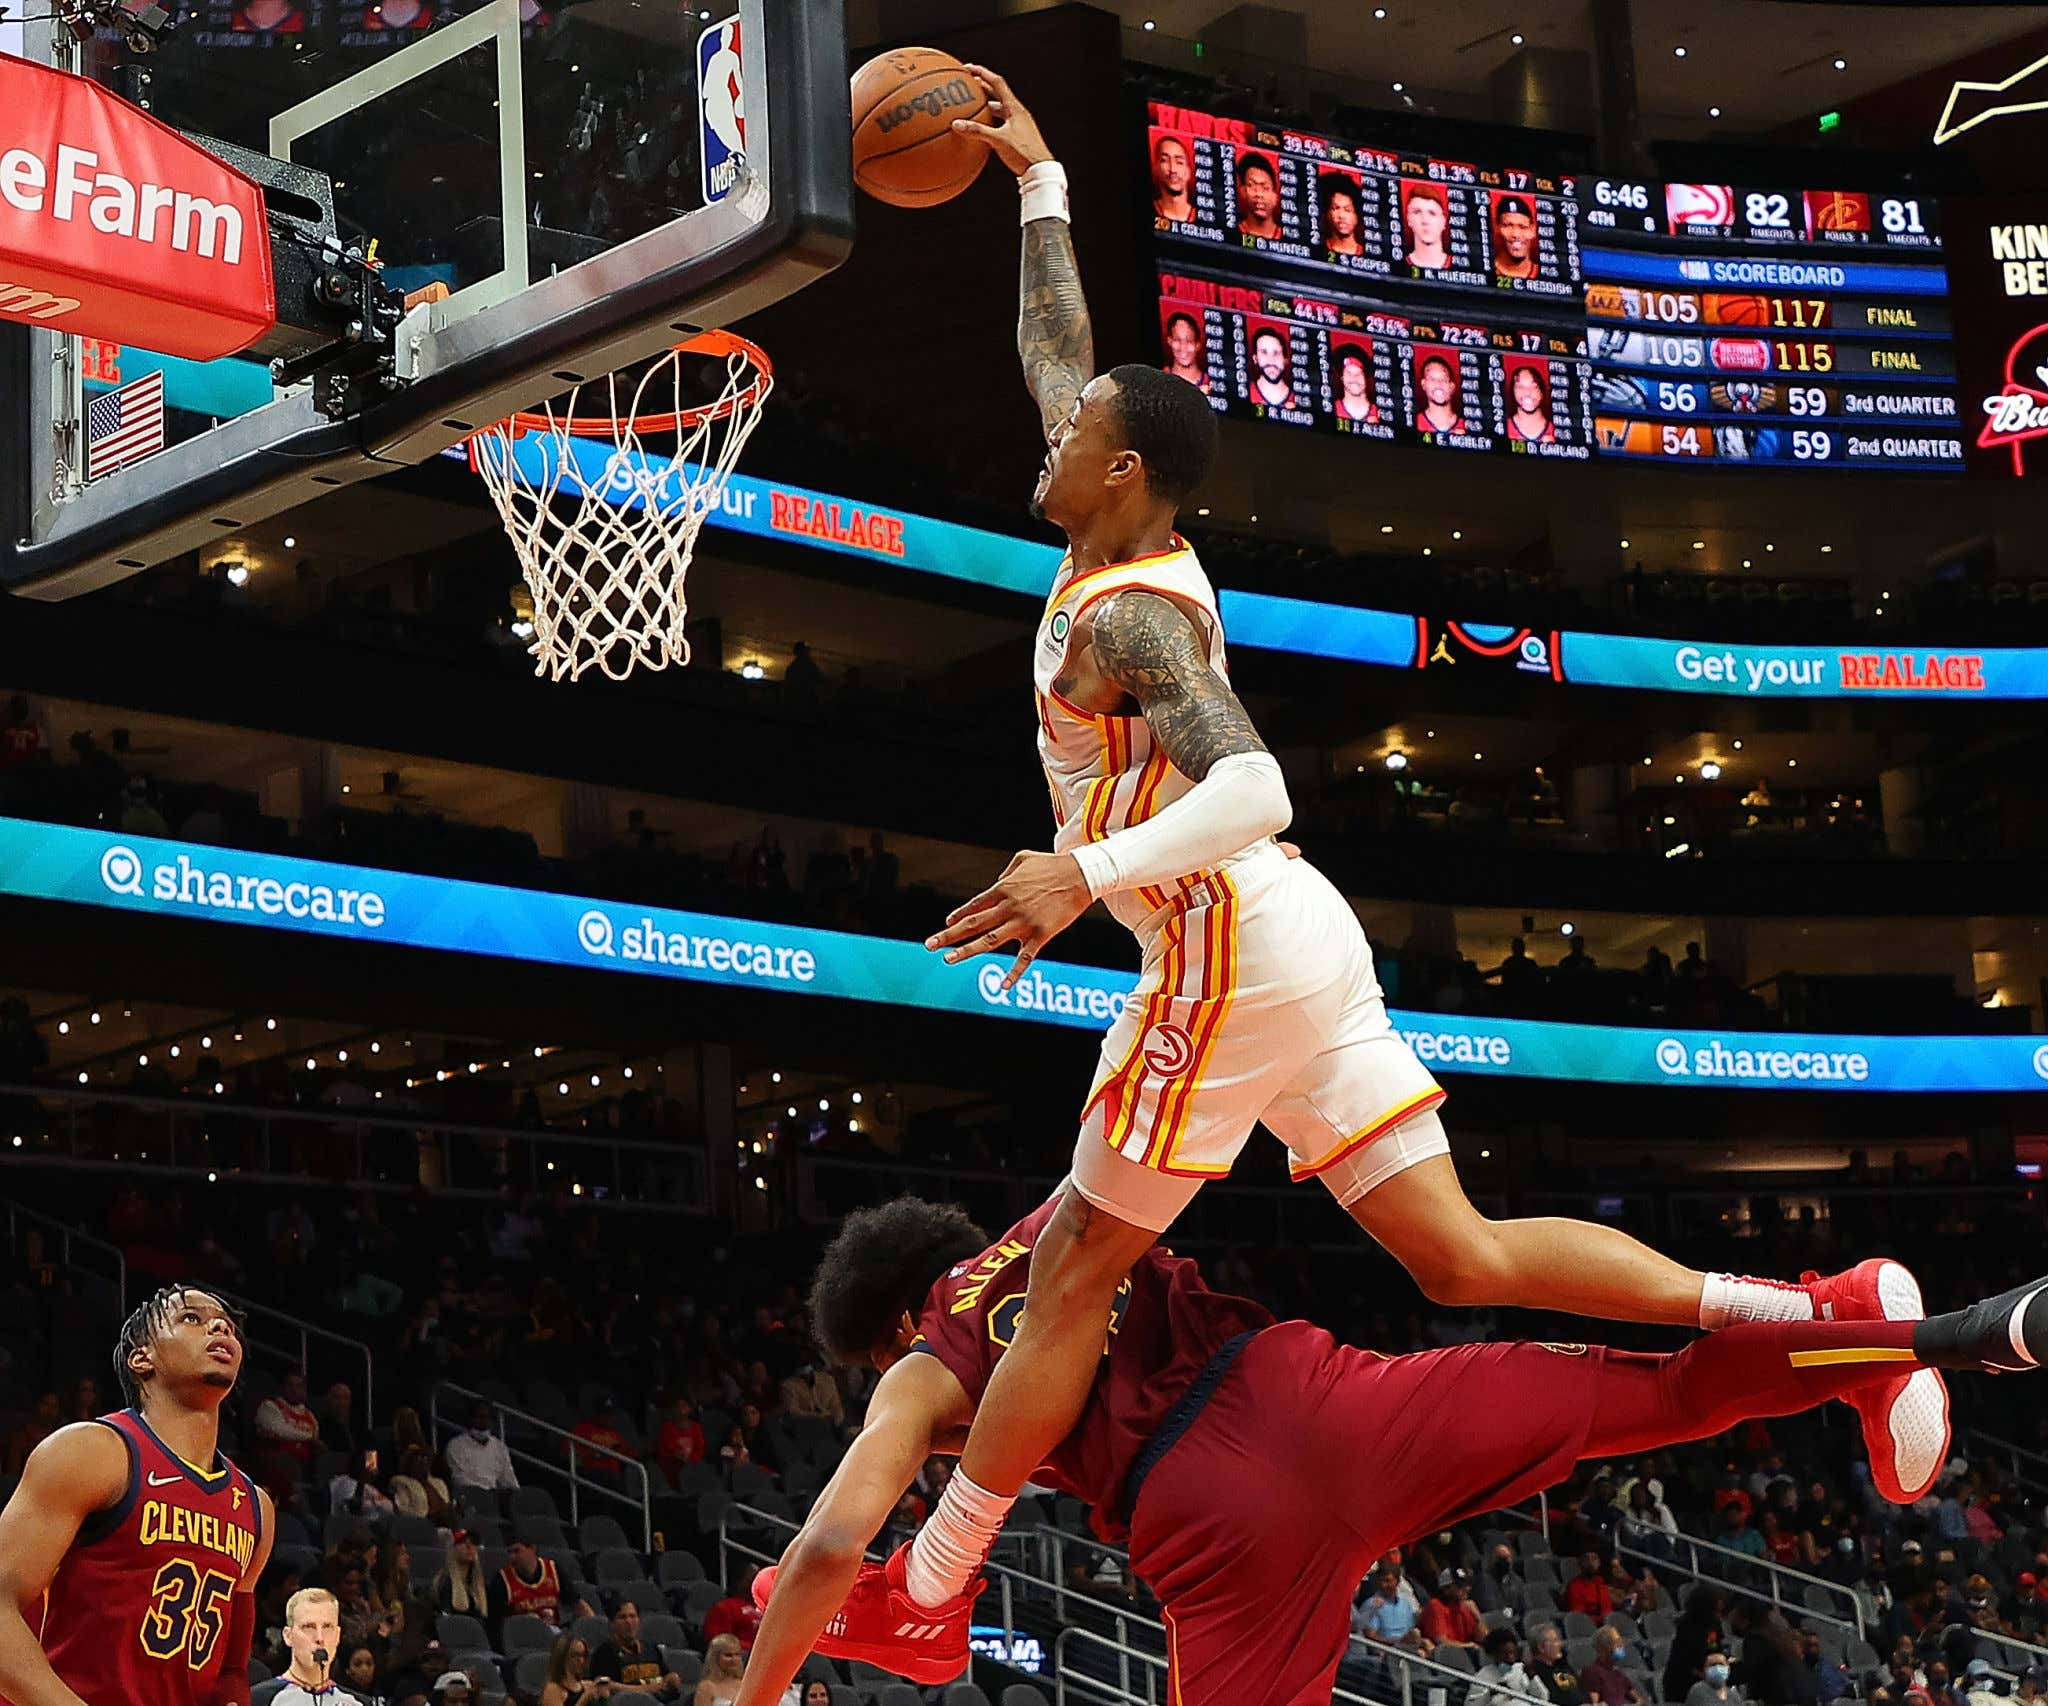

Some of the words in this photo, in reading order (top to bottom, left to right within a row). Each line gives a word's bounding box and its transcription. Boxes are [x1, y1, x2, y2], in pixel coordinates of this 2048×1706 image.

[1283, 135, 1327, 158] 39.5%
[1355, 150, 1398, 173] 39.1%
[1428, 162, 1475, 184] 81.3%
[1508, 173, 1527, 190] 17
[1562, 180, 1575, 196] 2
[1595, 180, 1648, 209] 6:46
[1745, 193, 1790, 227] 82
[1587, 210, 1616, 227] 4TH
[1881, 199, 1925, 233] 81
[1713, 262, 1846, 287] SCOREBOARD
[1643, 292, 1698, 323] 105
[1772, 299, 1826, 327] 117
[1866, 307, 1918, 327] FINAL
[1294, 302, 1338, 325] 44.1%
[1366, 315, 1410, 338] 29.6%
[1440, 325, 1488, 346] 72.2%
[1521, 334, 1541, 351] 17
[1576, 341, 1587, 356] 4
[1648, 336, 1701, 367] 105
[1776, 342, 1832, 372] 115
[1871, 351, 1922, 370] FINAL
[1280, 408, 1314, 426] RUBIO
[1659, 382, 1697, 412] 56
[1788, 387, 1827, 416] 59
[1845, 394, 1874, 413] 3rd
[1876, 395, 1956, 415] QUARTER
[1662, 425, 1700, 456] 54
[1792, 430, 1831, 460] 59
[1847, 437, 1880, 456] 2nd
[1883, 438, 1962, 458] QUARTER
[770, 489, 905, 557] REALAGE
[1675, 647, 1738, 682] Get
[1744, 656, 1826, 692] your
[1839, 653, 1986, 690] REALAGE
[154, 855, 386, 928] sharecare
[622, 917, 817, 982] sharecare
[1694, 1040, 1869, 1081] sharecare
[949, 1238, 1032, 1315] ALLEN
[140, 1499, 256, 1578] CLEVELAND
[139, 1557, 237, 1671] 35
